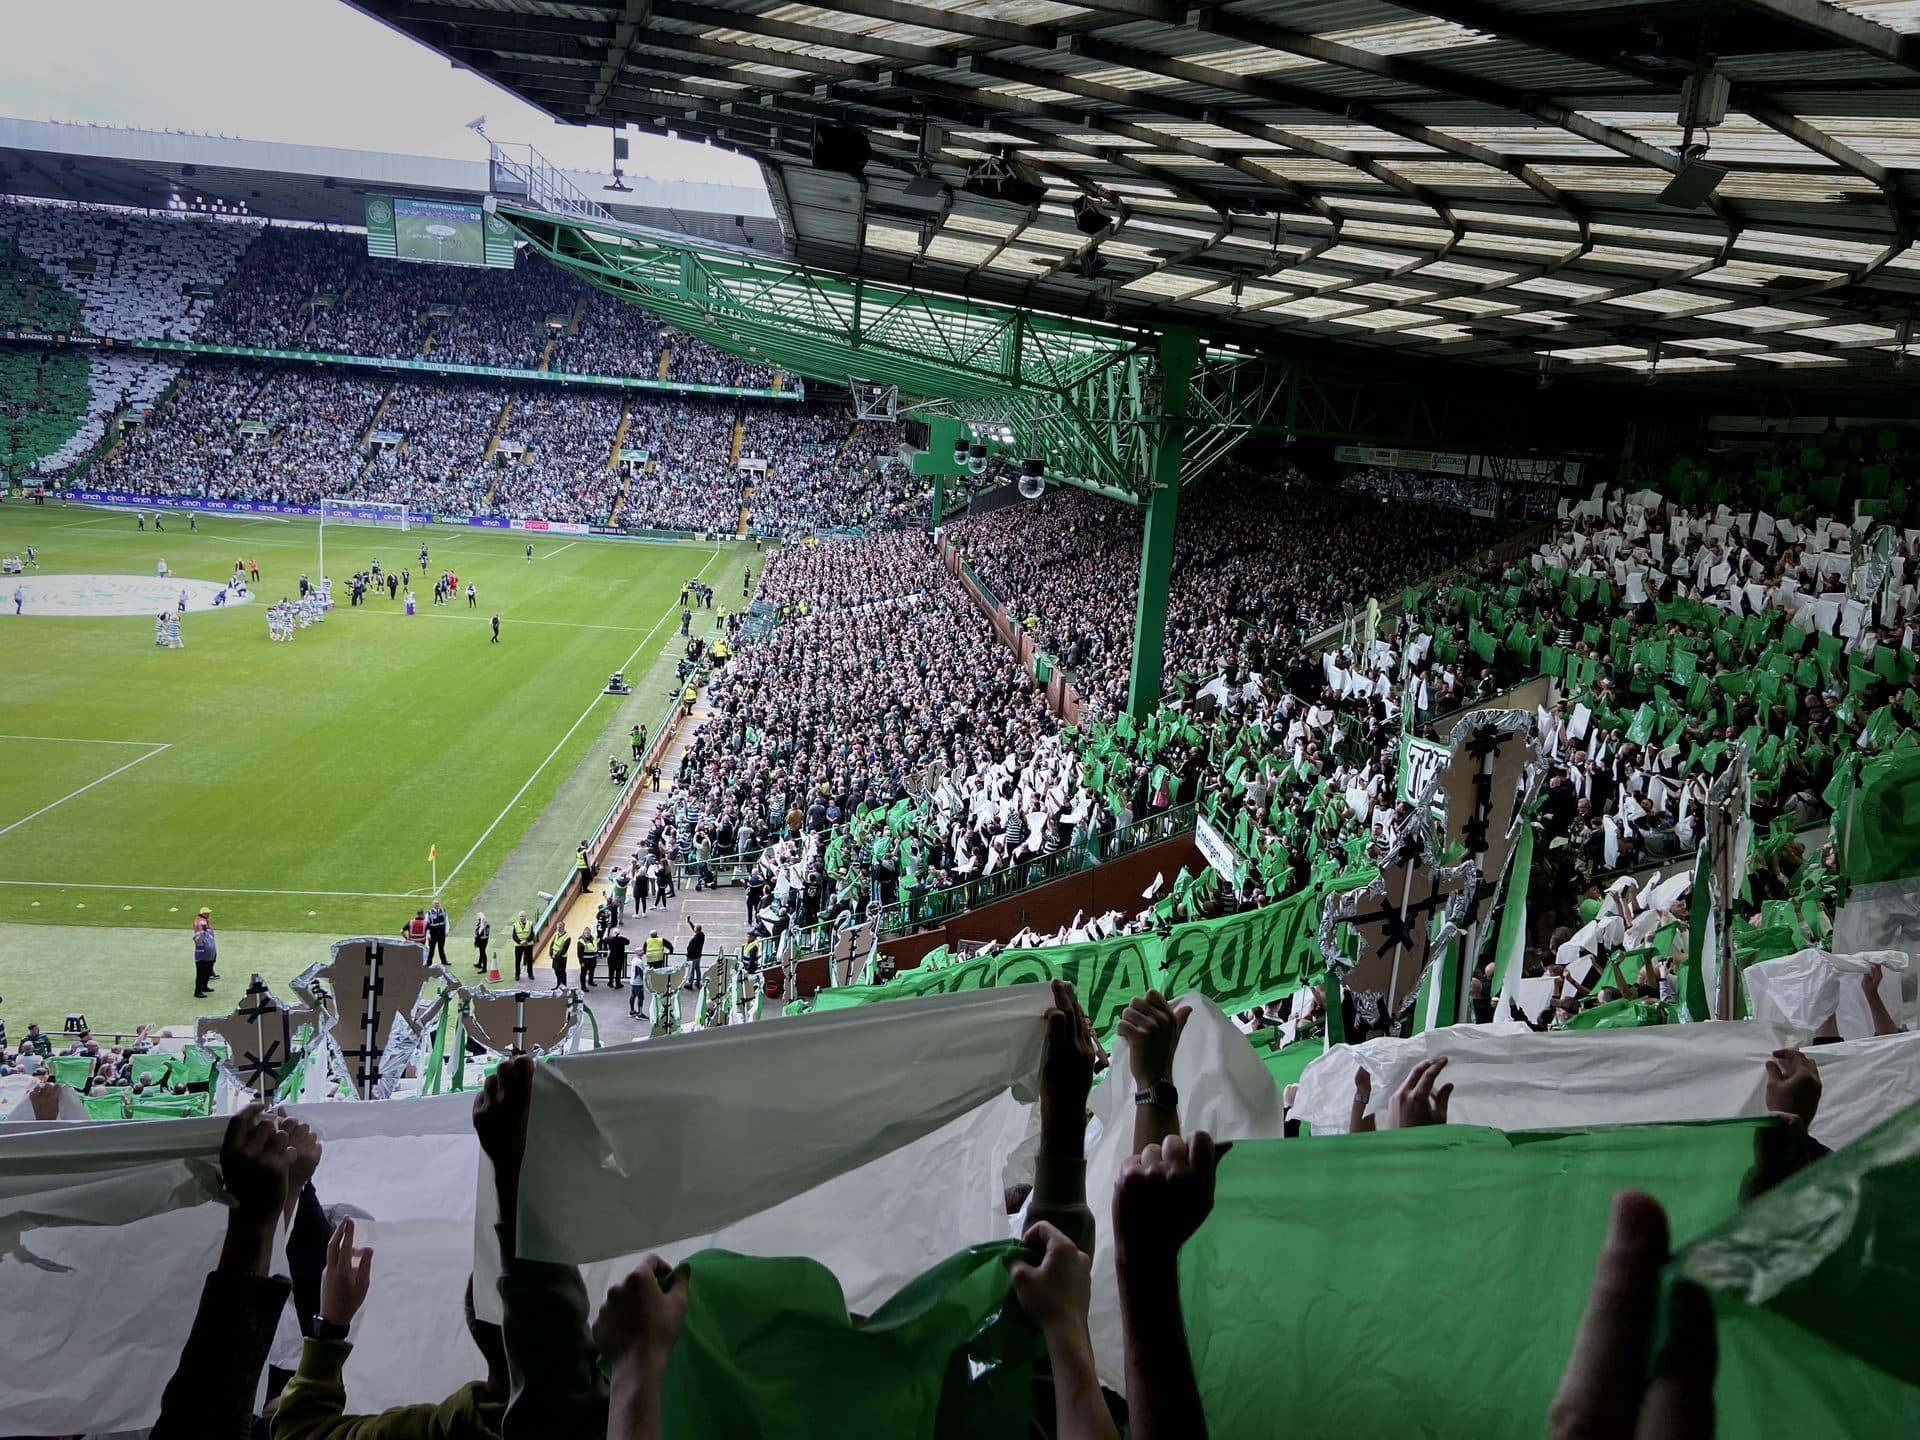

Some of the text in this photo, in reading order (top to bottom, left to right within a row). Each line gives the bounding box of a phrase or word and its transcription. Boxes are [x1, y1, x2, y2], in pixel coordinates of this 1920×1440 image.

[20, 333, 52, 341] MAGNERS
[70, 336, 101, 344] MAGNERS
[82, 492, 101, 500] cinch
[107, 494, 126, 502] cinch
[132, 495, 151, 504] cinch
[157, 498, 177, 506] cinc
[182, 499, 201, 507] cinch
[207, 501, 226, 509] cinch
[233, 502, 252, 510] cinch
[258, 503, 278, 511] cinch
[283, 505, 303, 513] cinch
[333, 510, 352, 518] cinch
[441, 515, 470, 524] dafabet
[512, 521, 548, 530] sky sports
